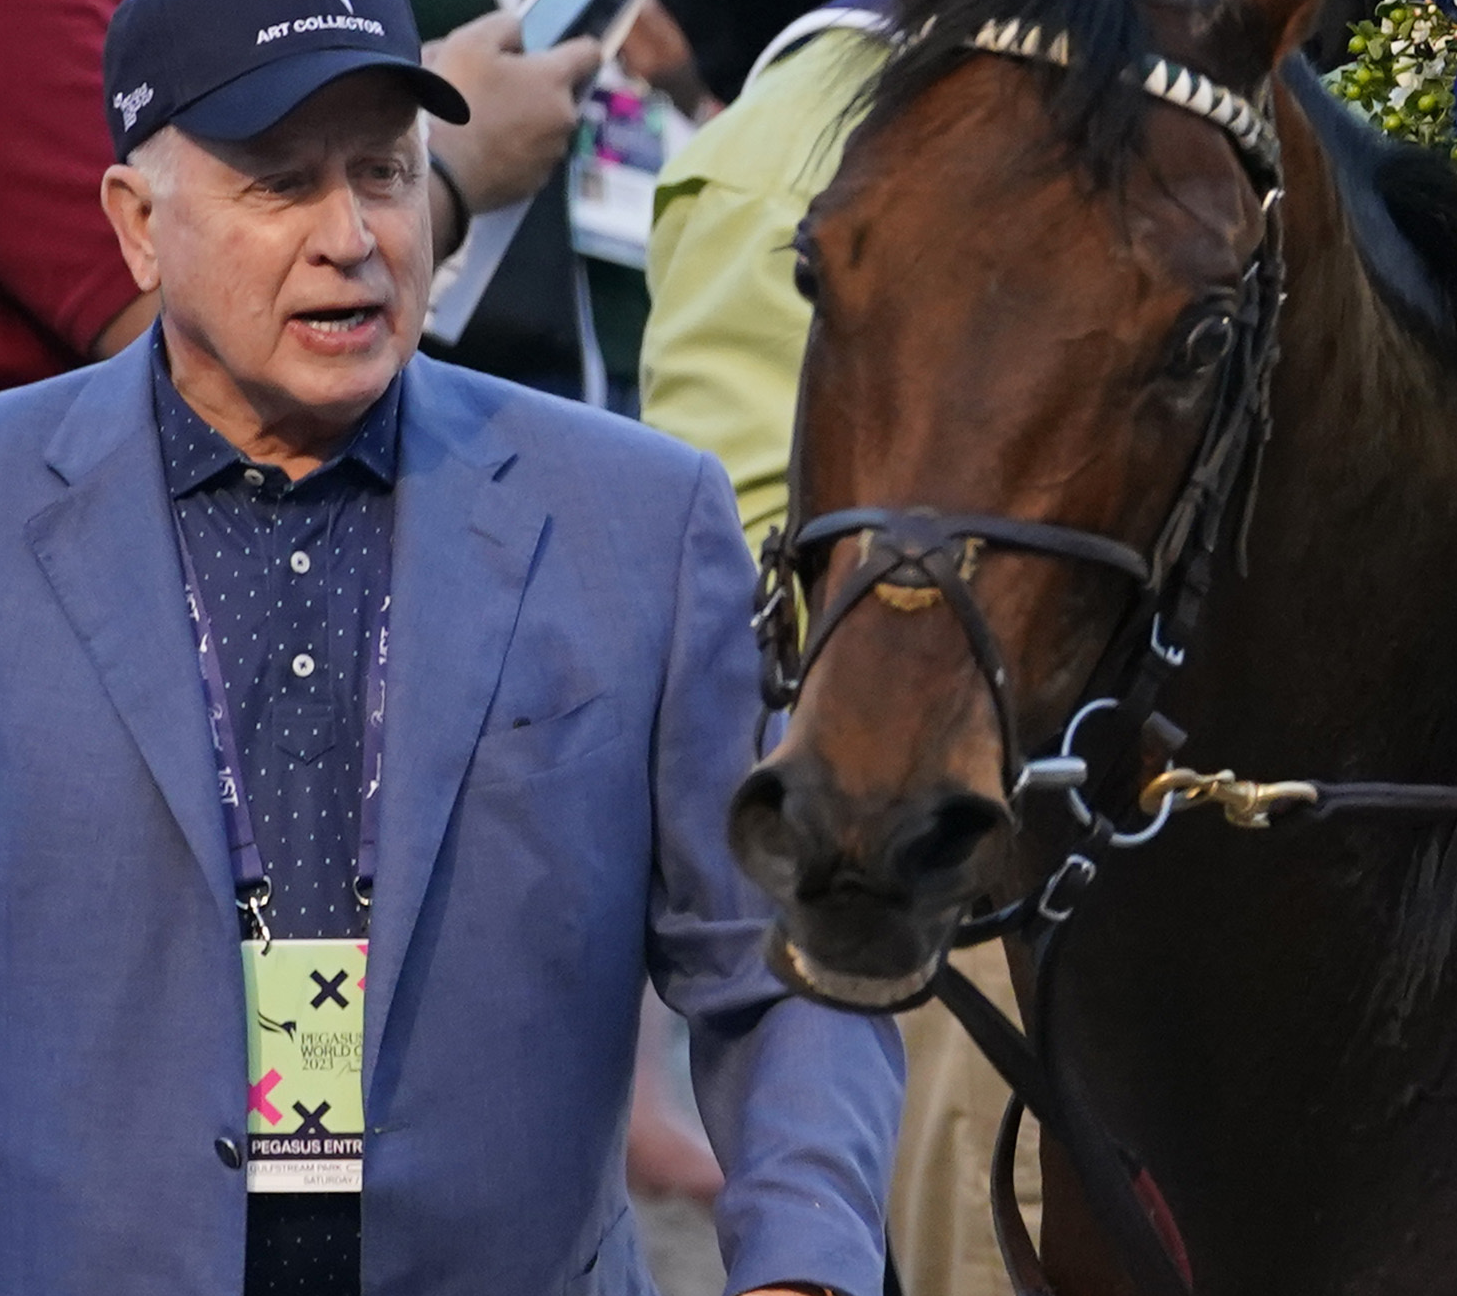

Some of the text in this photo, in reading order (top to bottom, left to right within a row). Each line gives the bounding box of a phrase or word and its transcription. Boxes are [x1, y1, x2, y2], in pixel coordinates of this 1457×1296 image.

[255, 15, 385, 46] ART COLLECTOR
[301, 1044, 351, 1057] WORLD
[251, 1139, 322, 1155] PEGASUS
